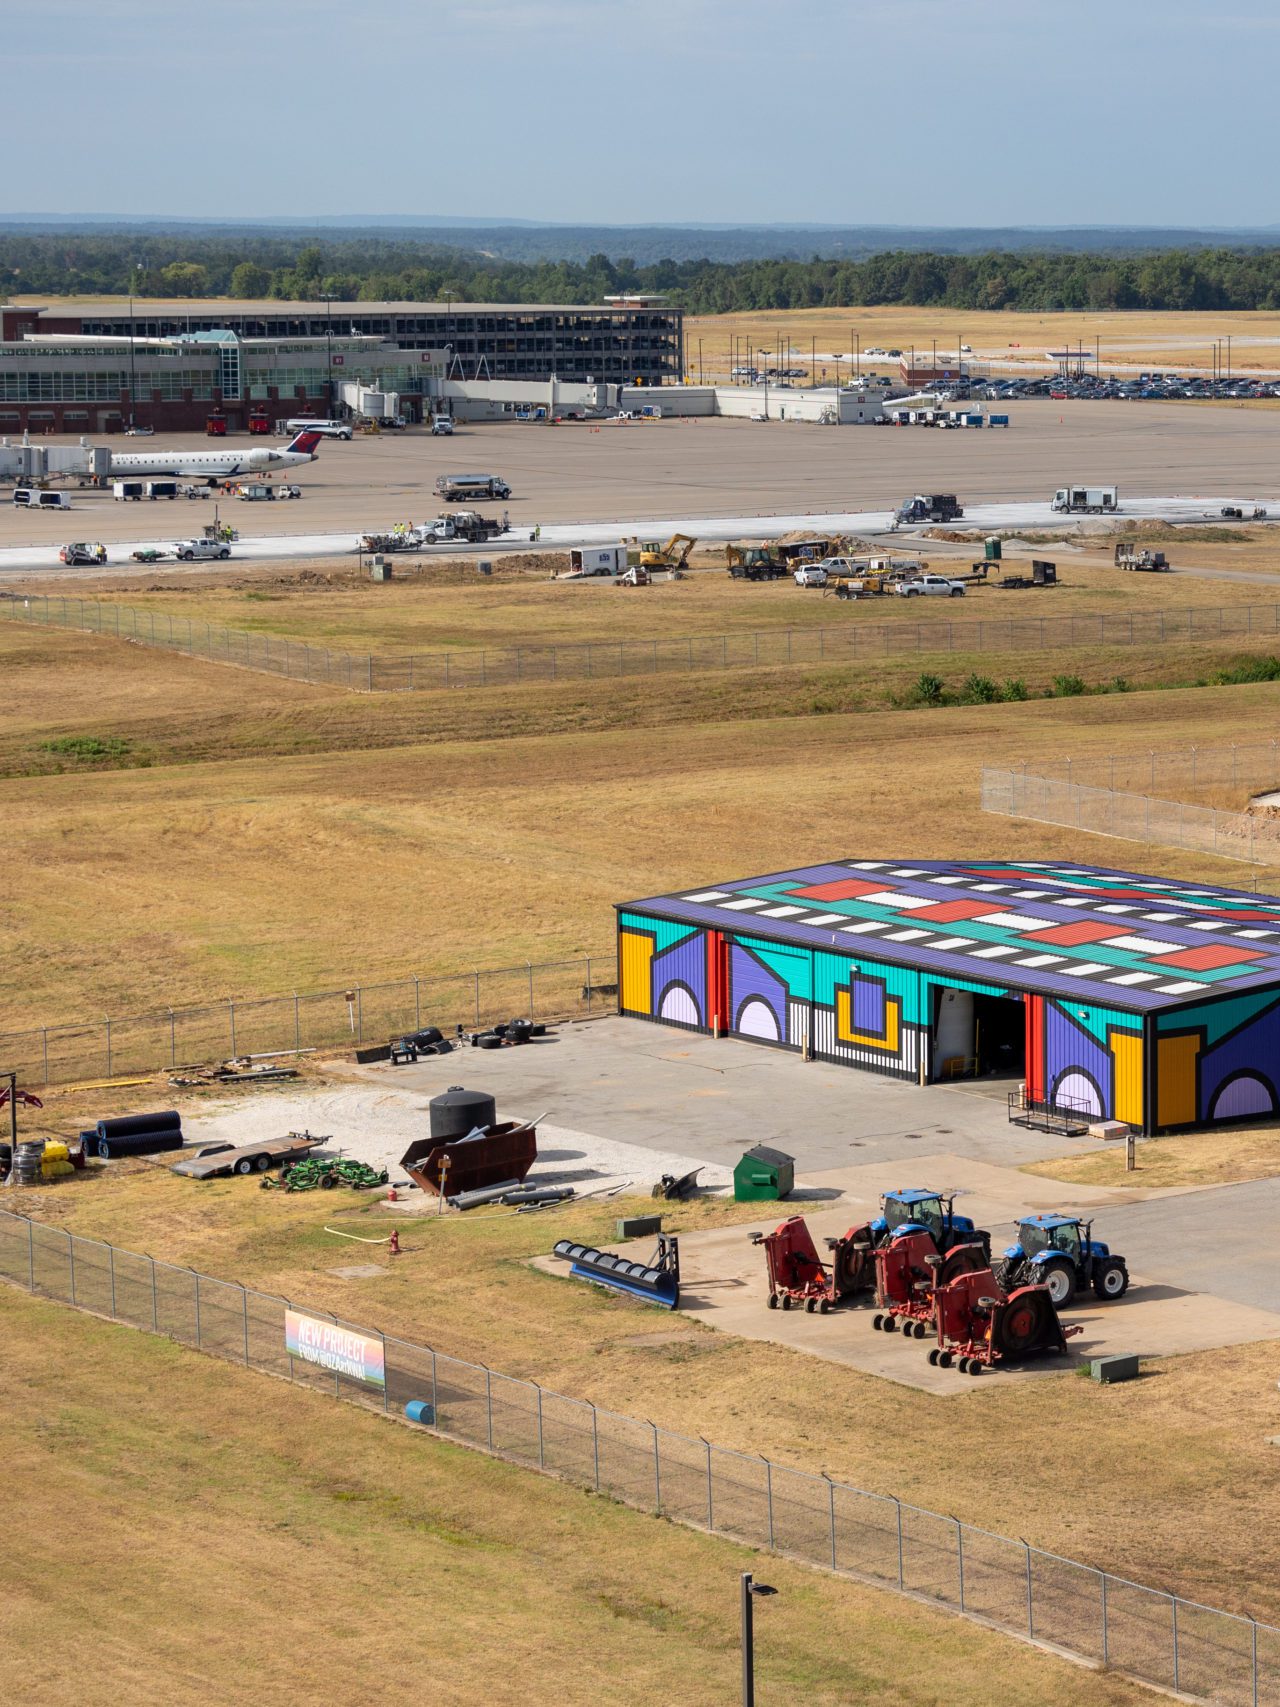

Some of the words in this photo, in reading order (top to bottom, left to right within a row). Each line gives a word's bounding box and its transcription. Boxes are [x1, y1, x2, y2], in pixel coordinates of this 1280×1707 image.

[298, 1319, 323, 1347] NEW
[323, 1327, 367, 1363] PROJECT
[298, 1343, 320, 1364] FROM
